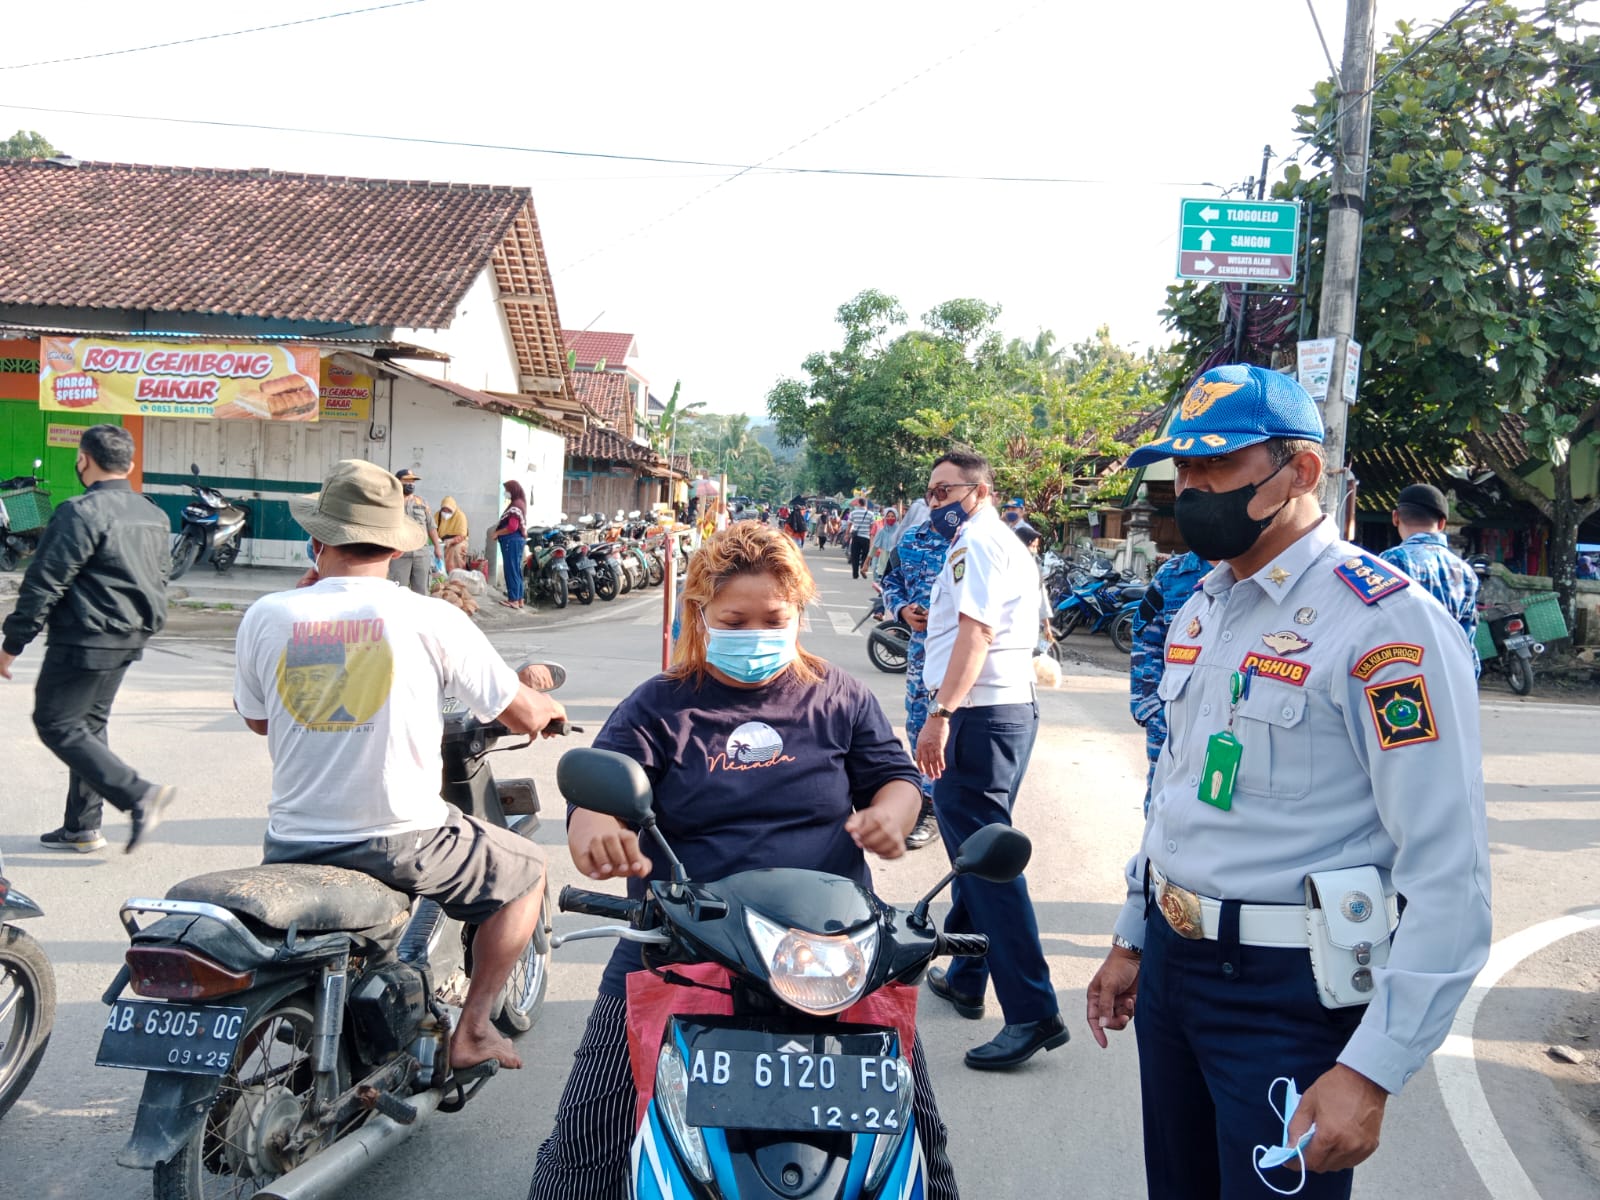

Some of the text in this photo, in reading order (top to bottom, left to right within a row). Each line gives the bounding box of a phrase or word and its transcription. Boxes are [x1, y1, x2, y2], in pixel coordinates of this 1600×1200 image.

[1227, 209, 1279, 223] TLOGOLELO
[1231, 235, 1271, 248] SANGON
[1227, 256, 1272, 265] WISATA ALAM
[83, 346, 271, 376] ROTI GEMBONG
[56, 376, 93, 388] HARGA
[136, 377, 218, 402] BAKAR
[56, 388, 98, 400] SPESIAL
[326, 399, 351, 407] BAKAR
[293, 618, 384, 645] WIRANTO
[1369, 648, 1393, 665] KULON
[1393, 648, 1418, 659] PROGO
[1245, 656, 1303, 681] DISHUB
[708, 750, 796, 773] Nevada
[106, 1005, 134, 1032] AB
[144, 1009, 201, 1037] 6305
[690, 1050, 899, 1092] AB 6120 FC
